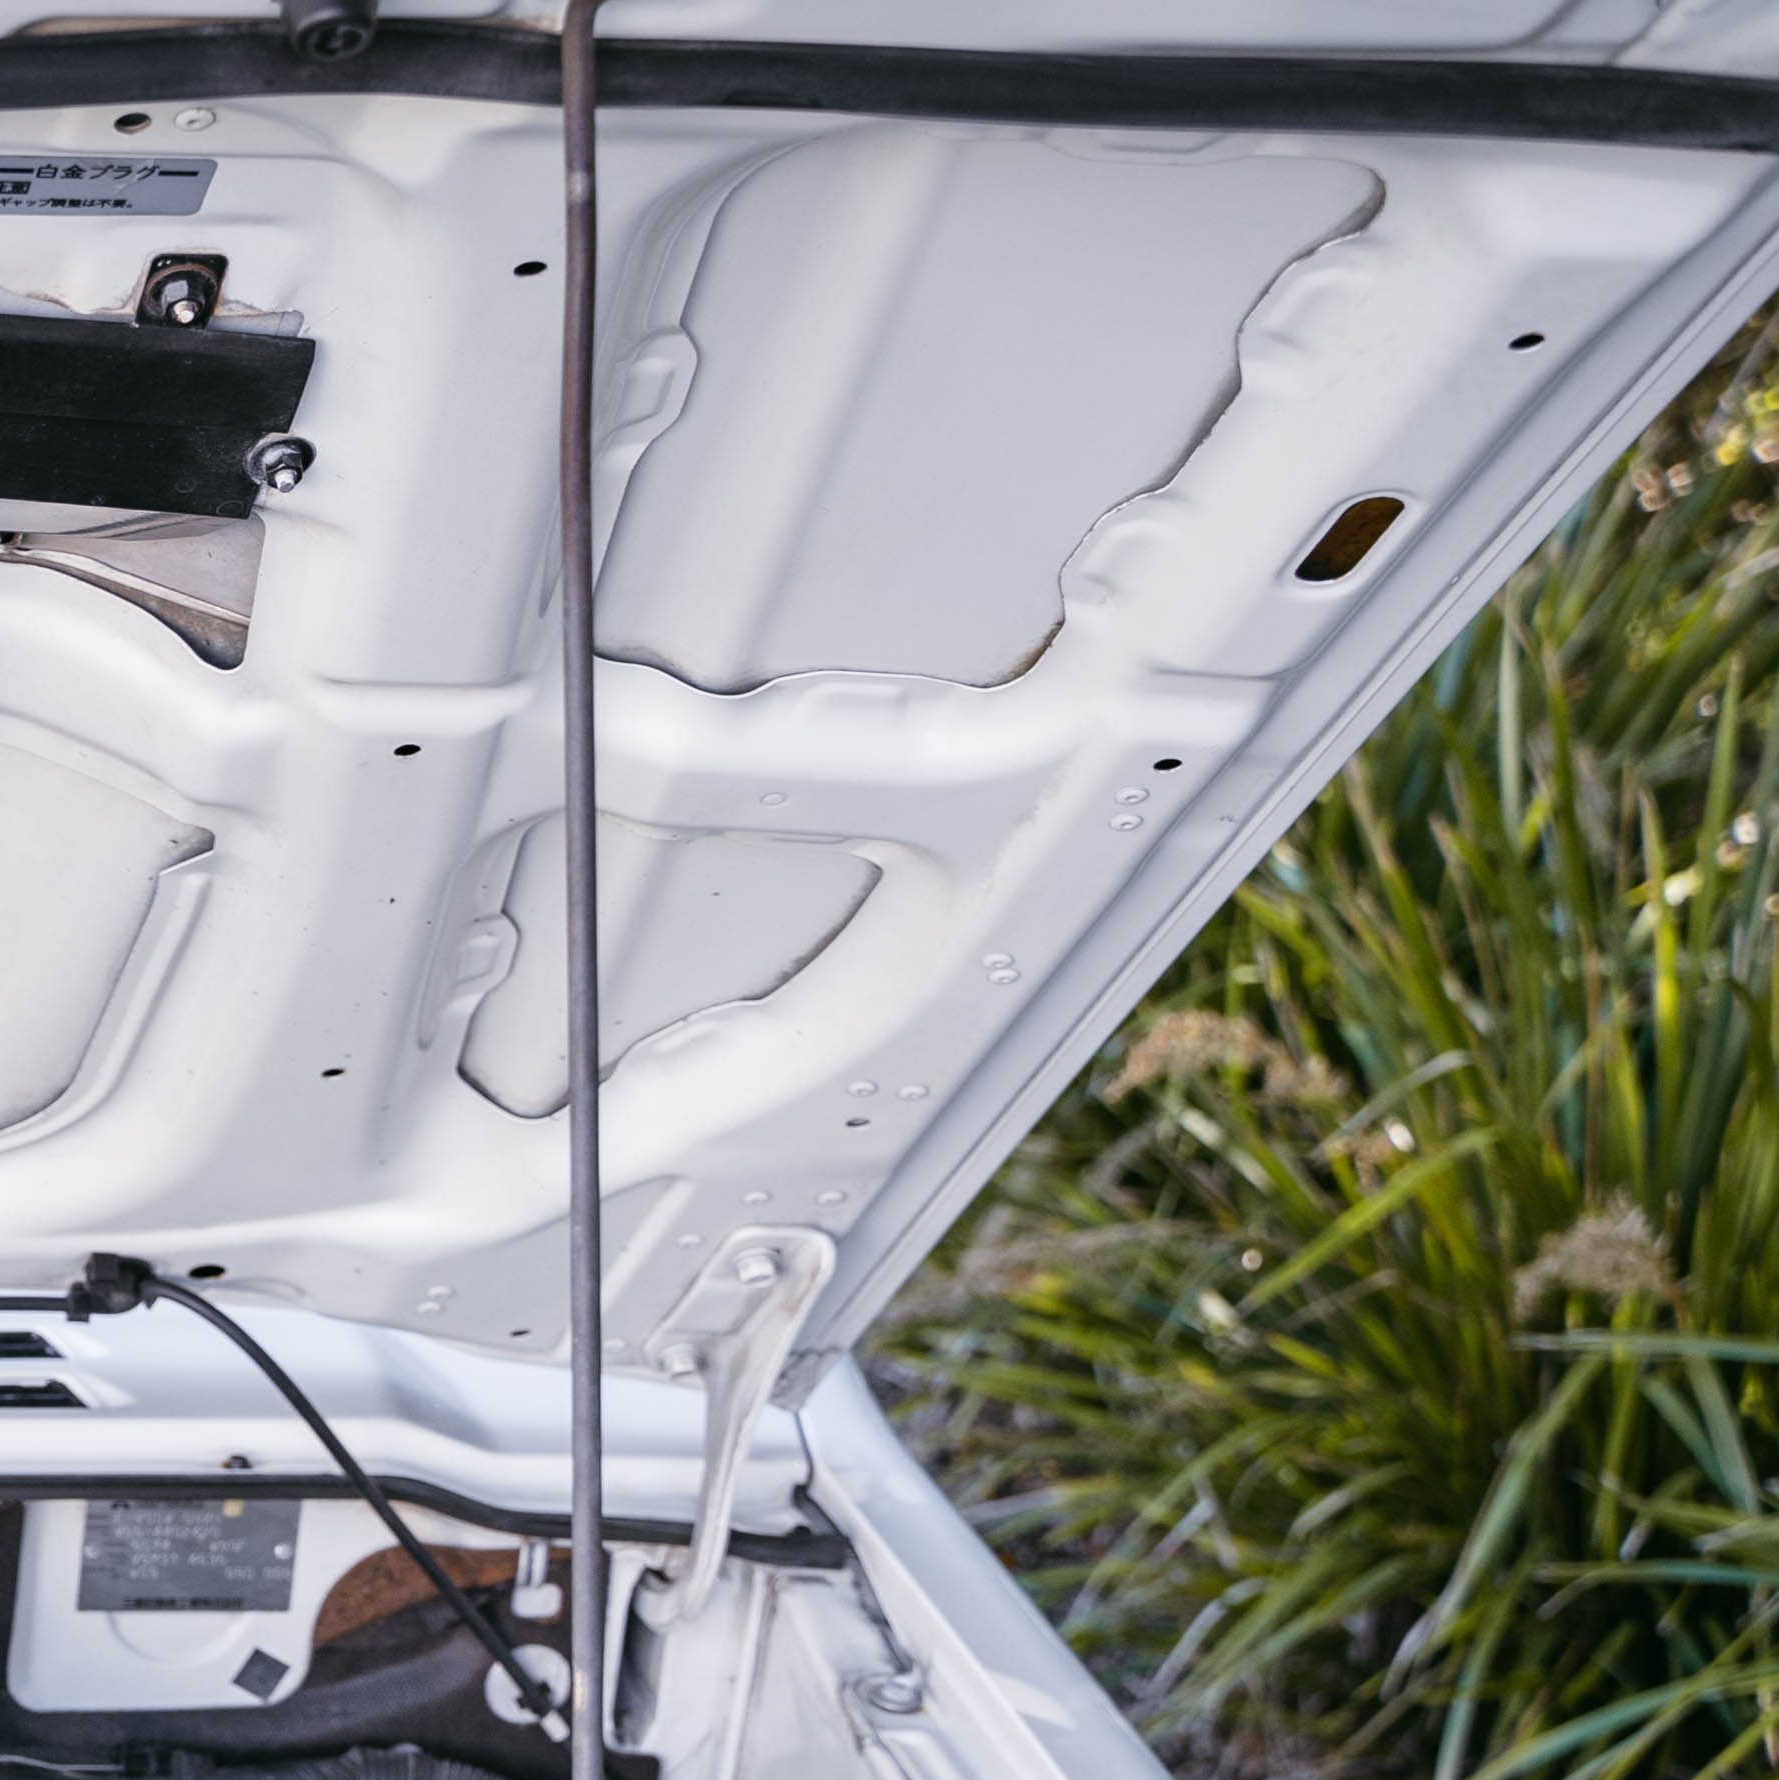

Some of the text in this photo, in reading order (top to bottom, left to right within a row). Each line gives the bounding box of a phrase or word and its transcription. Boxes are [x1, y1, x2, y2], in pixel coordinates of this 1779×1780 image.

[35, 163, 159, 180] 白金プラグ
